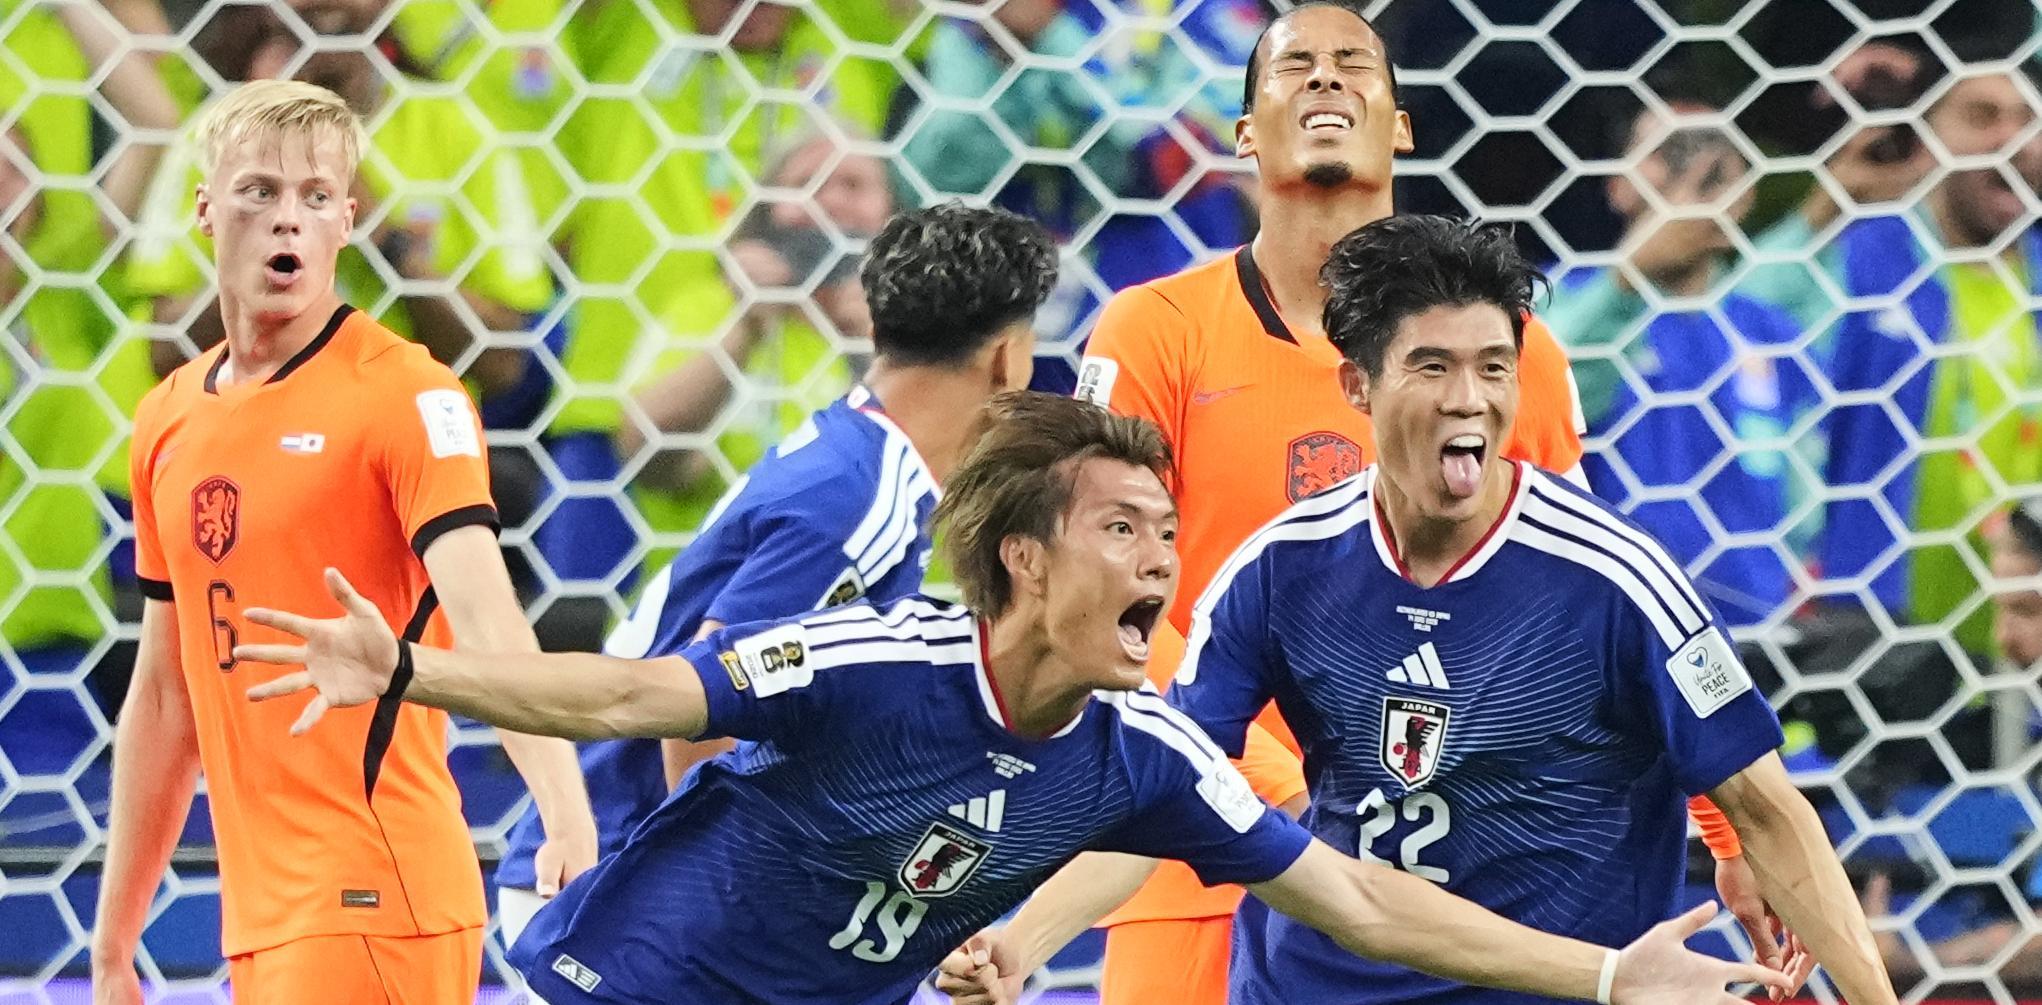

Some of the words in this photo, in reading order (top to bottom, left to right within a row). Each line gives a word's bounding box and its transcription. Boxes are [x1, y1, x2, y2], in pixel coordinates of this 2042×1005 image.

[207, 579, 238, 673] 6
[1401, 702, 1436, 714] JAPAN
[1701, 672, 1730, 695] PEACE
[1356, 787, 1450, 884] 22
[829, 881, 929, 963] 19
